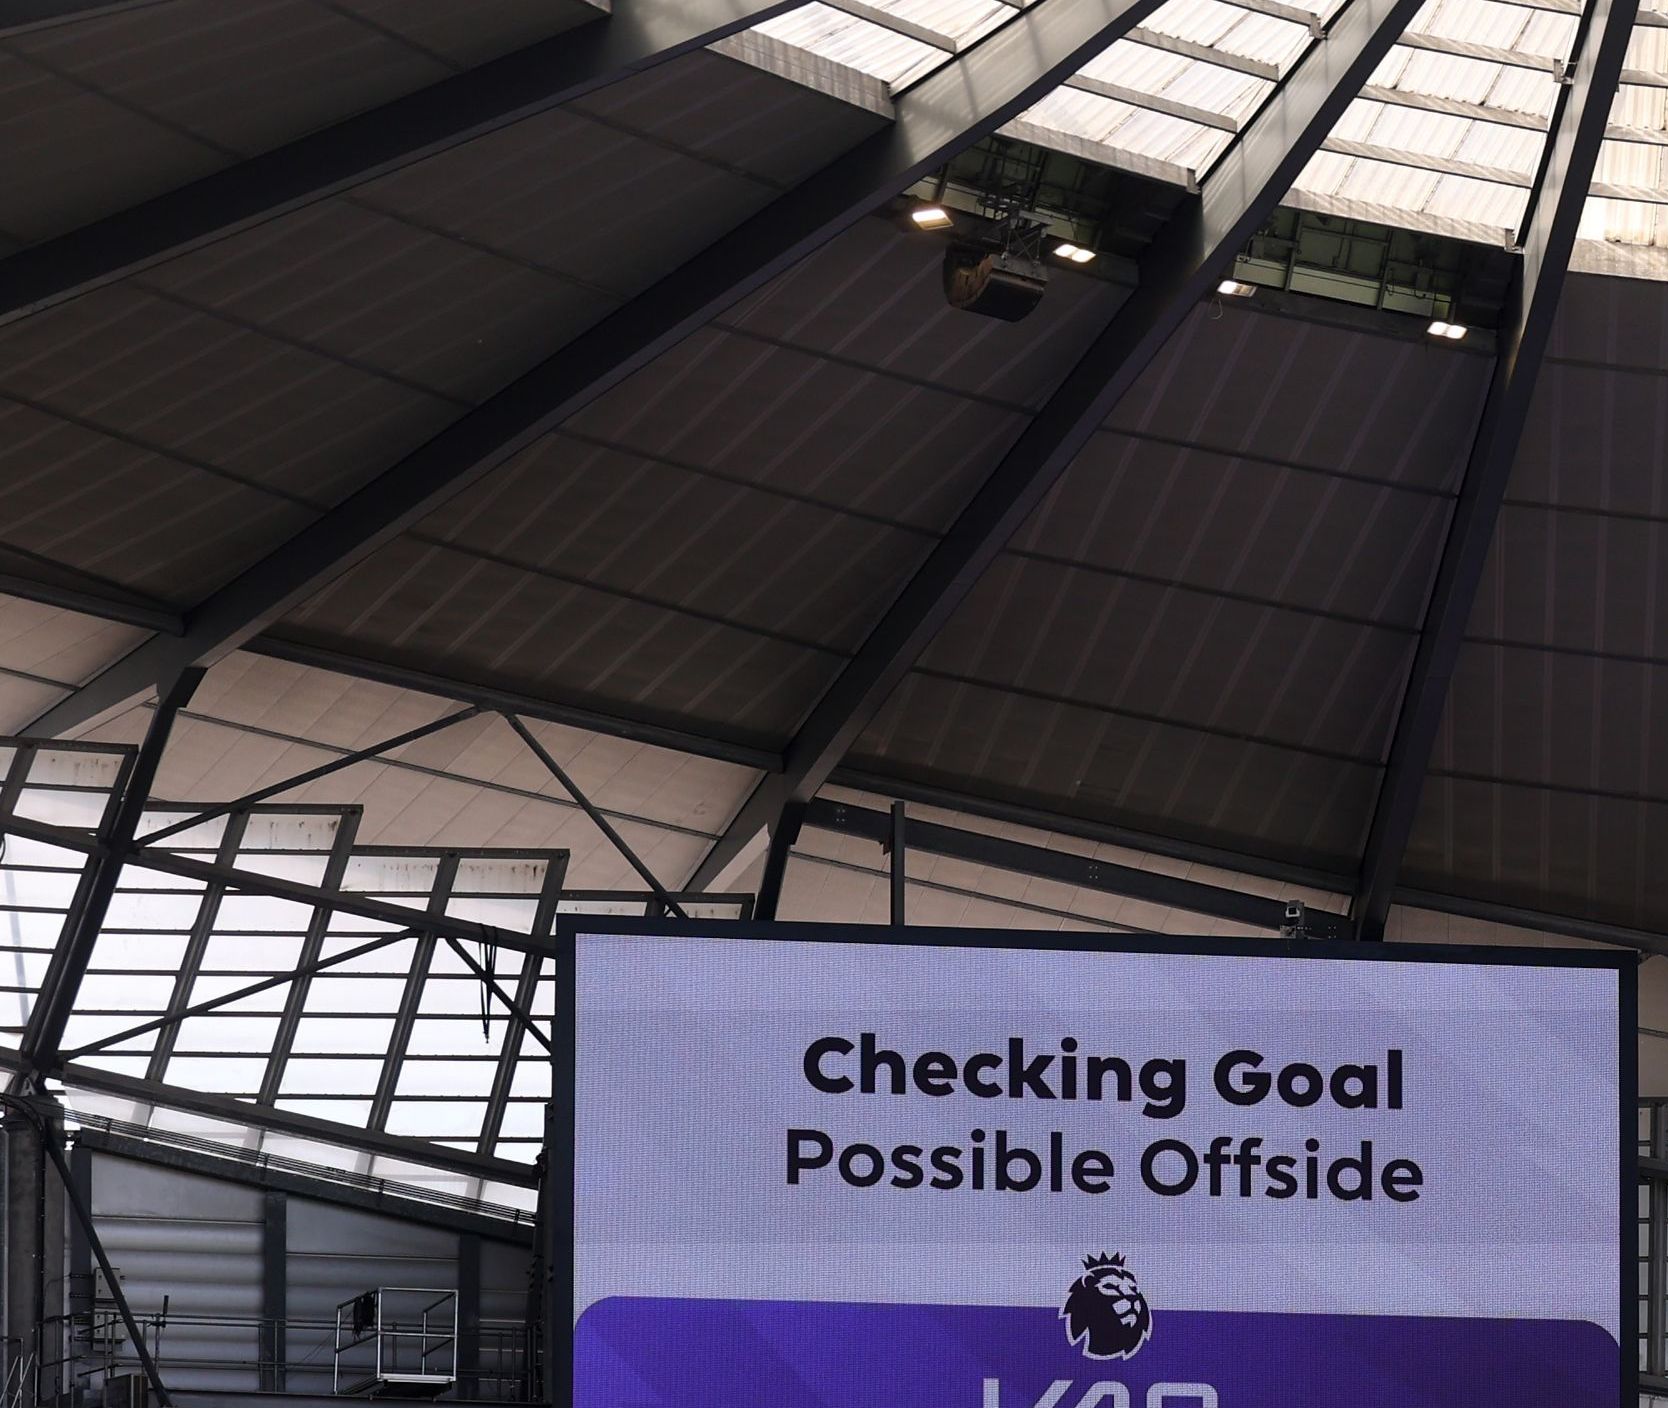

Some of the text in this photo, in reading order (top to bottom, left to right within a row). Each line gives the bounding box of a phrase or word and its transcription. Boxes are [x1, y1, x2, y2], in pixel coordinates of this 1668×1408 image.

[803, 1032, 1404, 1119] Checking Goal
[786, 1129, 1424, 1202] Possible Offside
